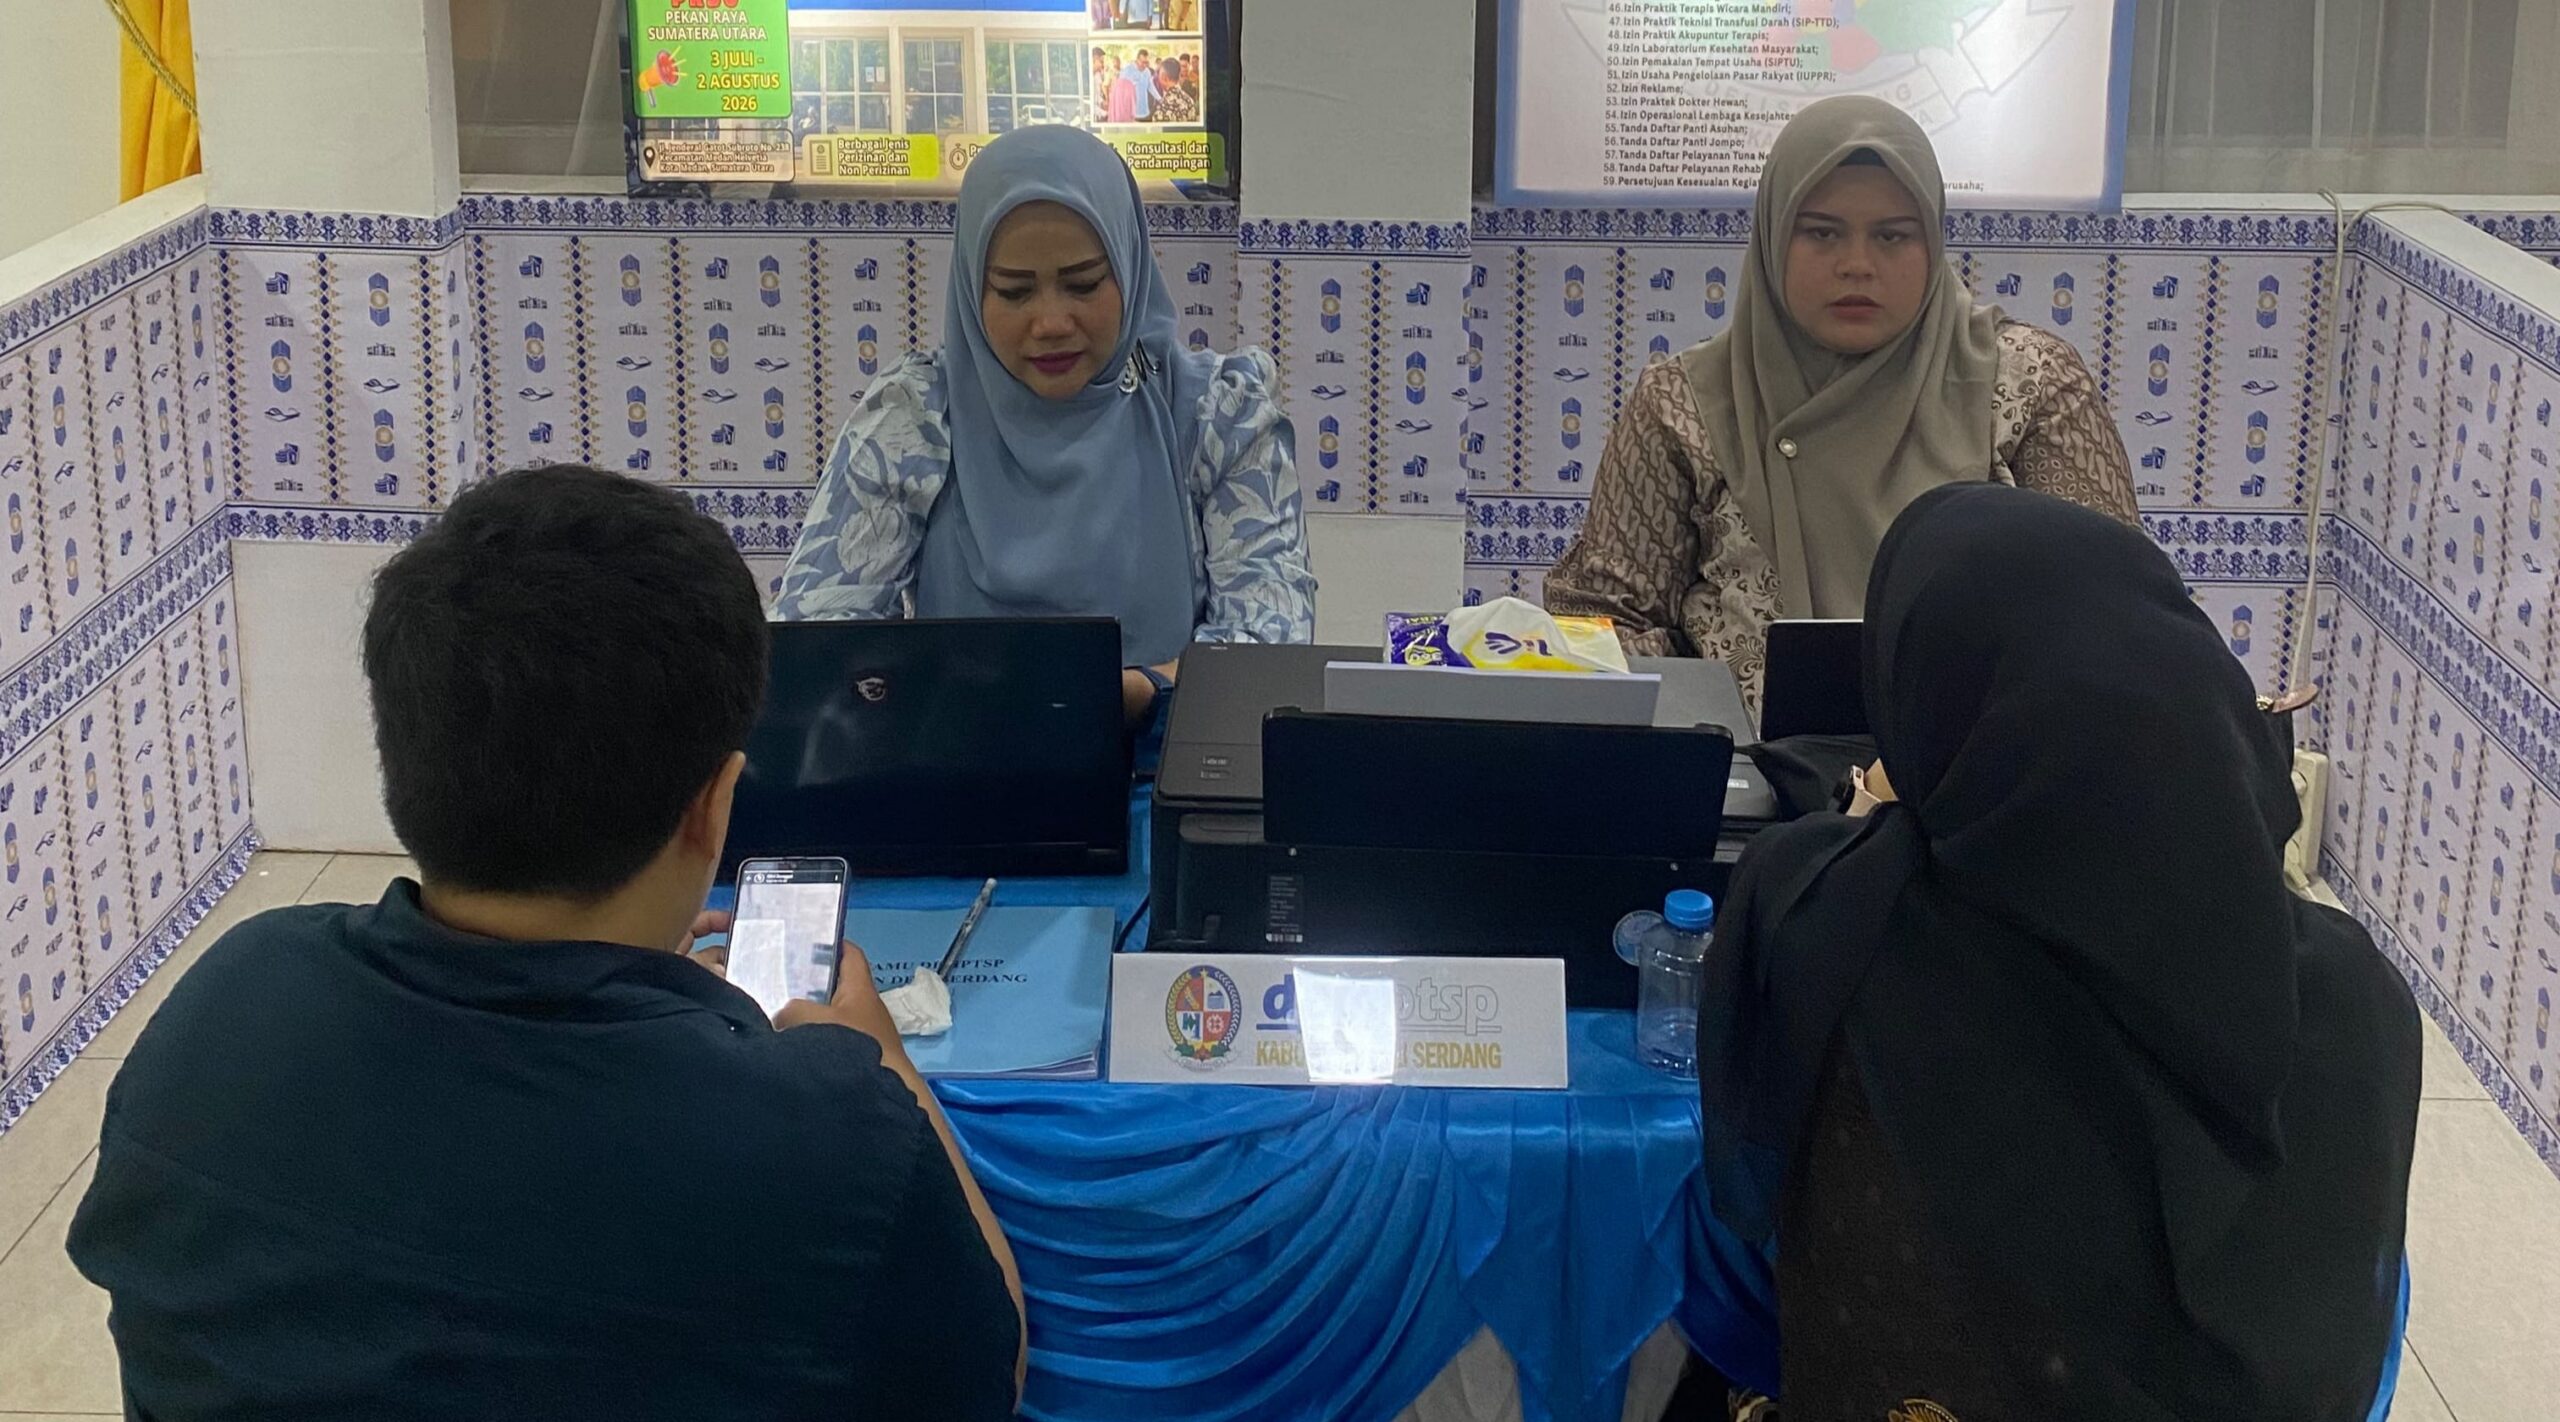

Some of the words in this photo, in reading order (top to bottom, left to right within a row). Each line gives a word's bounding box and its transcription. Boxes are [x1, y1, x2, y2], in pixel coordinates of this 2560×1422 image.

[1624, 4, 1641, 14] Izin
[1644, 4, 1677, 14] Praktik
[1680, 4, 1714, 14] Terapis
[1716, 4, 1749, 14] Wicara
[1752, 4, 1791, 14] Mandiri;
[666, 11, 709, 24] PEKAN
[713, 11, 747, 24] RAYA
[1624, 17, 1641, 28] Izin
[1643, 17, 1676, 28] Praktik
[1679, 17, 1712, 28] Teknisi
[1715, 17, 1758, 28] Transfusi
[1761, 17, 1789, 28] Darah
[1792, 17, 1840, 28] (SIP-TTD);
[648, 27, 719, 40] SUMATERA
[722, 27, 767, 40] UTARA
[1623, 30, 1640, 42] Izin
[1643, 30, 1676, 42] Praktik
[1678, 30, 1728, 42] Akupuntur
[1732, 30, 1769, 42] Terapis;
[1623, 44, 1639, 55] Izin
[1642, 44, 1707, 55] Laboratorium
[1710, 44, 1759, 55] Kesehatan
[1761, 44, 1819, 55] Masyarakat;
[711, 51, 720, 66] 3
[723, 51, 754, 70] JULI
[1622, 57, 1639, 69] Izin
[1695, 57, 1730, 69] Tempat
[1733, 57, 1761, 69] Usaha
[1764, 57, 1803, 69] (SIPTU);
[697, 74, 707, 89] 2
[710, 74, 780, 89] AGUSTUS
[1622, 70, 1638, 82] Izin
[1641, 70, 1670, 82] Usaha
[1673, 70, 1730, 82] Pengelolaan
[1733, 70, 1758, 82] Pasar
[1761, 70, 1794, 82] Rakyat
[1621, 83, 1638, 94] Izin
[1640, 83, 1683, 94] Reklame;
[722, 96, 757, 111] 2026
[1621, 97, 1637, 108] Izin
[1640, 97, 1676, 108] Praktek
[1678, 97, 1710, 108] Dokter
[1713, 97, 1747, 108] Hewan;
[1620, 110, 1637, 122] Izin
[1640, 110, 1696, 122] Operasional
[1699, 110, 1741, 122] Lembaga
[1620, 124, 1647, 134] Tanda
[1651, 124, 1681, 134] Daftar
[1683, 124, 1707, 134] Panti
[1710, 124, 1748, 134] Asuhan;
[727, 143, 759, 152] Subroto
[837, 138, 883, 152] Berbagai
[884, 138, 910, 152] Jenis
[1126, 141, 1187, 154] Konsultasi
[1188, 141, 1210, 154] dan
[1620, 137, 1647, 148] Tanda
[1650, 137, 1680, 148] Daftar
[1683, 137, 1707, 148] Panti
[1709, 137, 1745, 148] Jompo;
[659, 153, 704, 162] Kecamatan
[706, 153, 733, 162] Medan
[838, 151, 886, 164] Perizinan
[888, 151, 909, 164] dan
[1619, 150, 1647, 162] Tanda
[1650, 150, 1679, 162] Daftar
[1682, 150, 1730, 162] Pelayanan
[1733, 150, 1755, 162] Tuna
[660, 163, 679, 173] Kota
[680, 163, 709, 173] Medan,
[711, 163, 750, 173] Sumatera
[751, 163, 774, 173] Utara
[1127, 156, 1212, 172] Pendampingan
[1619, 164, 1646, 175] Tanda
[1649, 164, 1679, 175] Daftar
[1682, 164, 1730, 175] Pelayanan
[1732, 164, 1762, 174] Rehab
[839, 164, 860, 177] Non
[862, 164, 910, 177] Perizinan
[1618, 177, 1674, 189] Persetujuan
[1732, 177, 1759, 189] Kegia
[872, 959, 914, 971] AMU
[951, 974, 1027, 985] ERDANG
[1412, 1042, 1502, 1068] SERDANG
